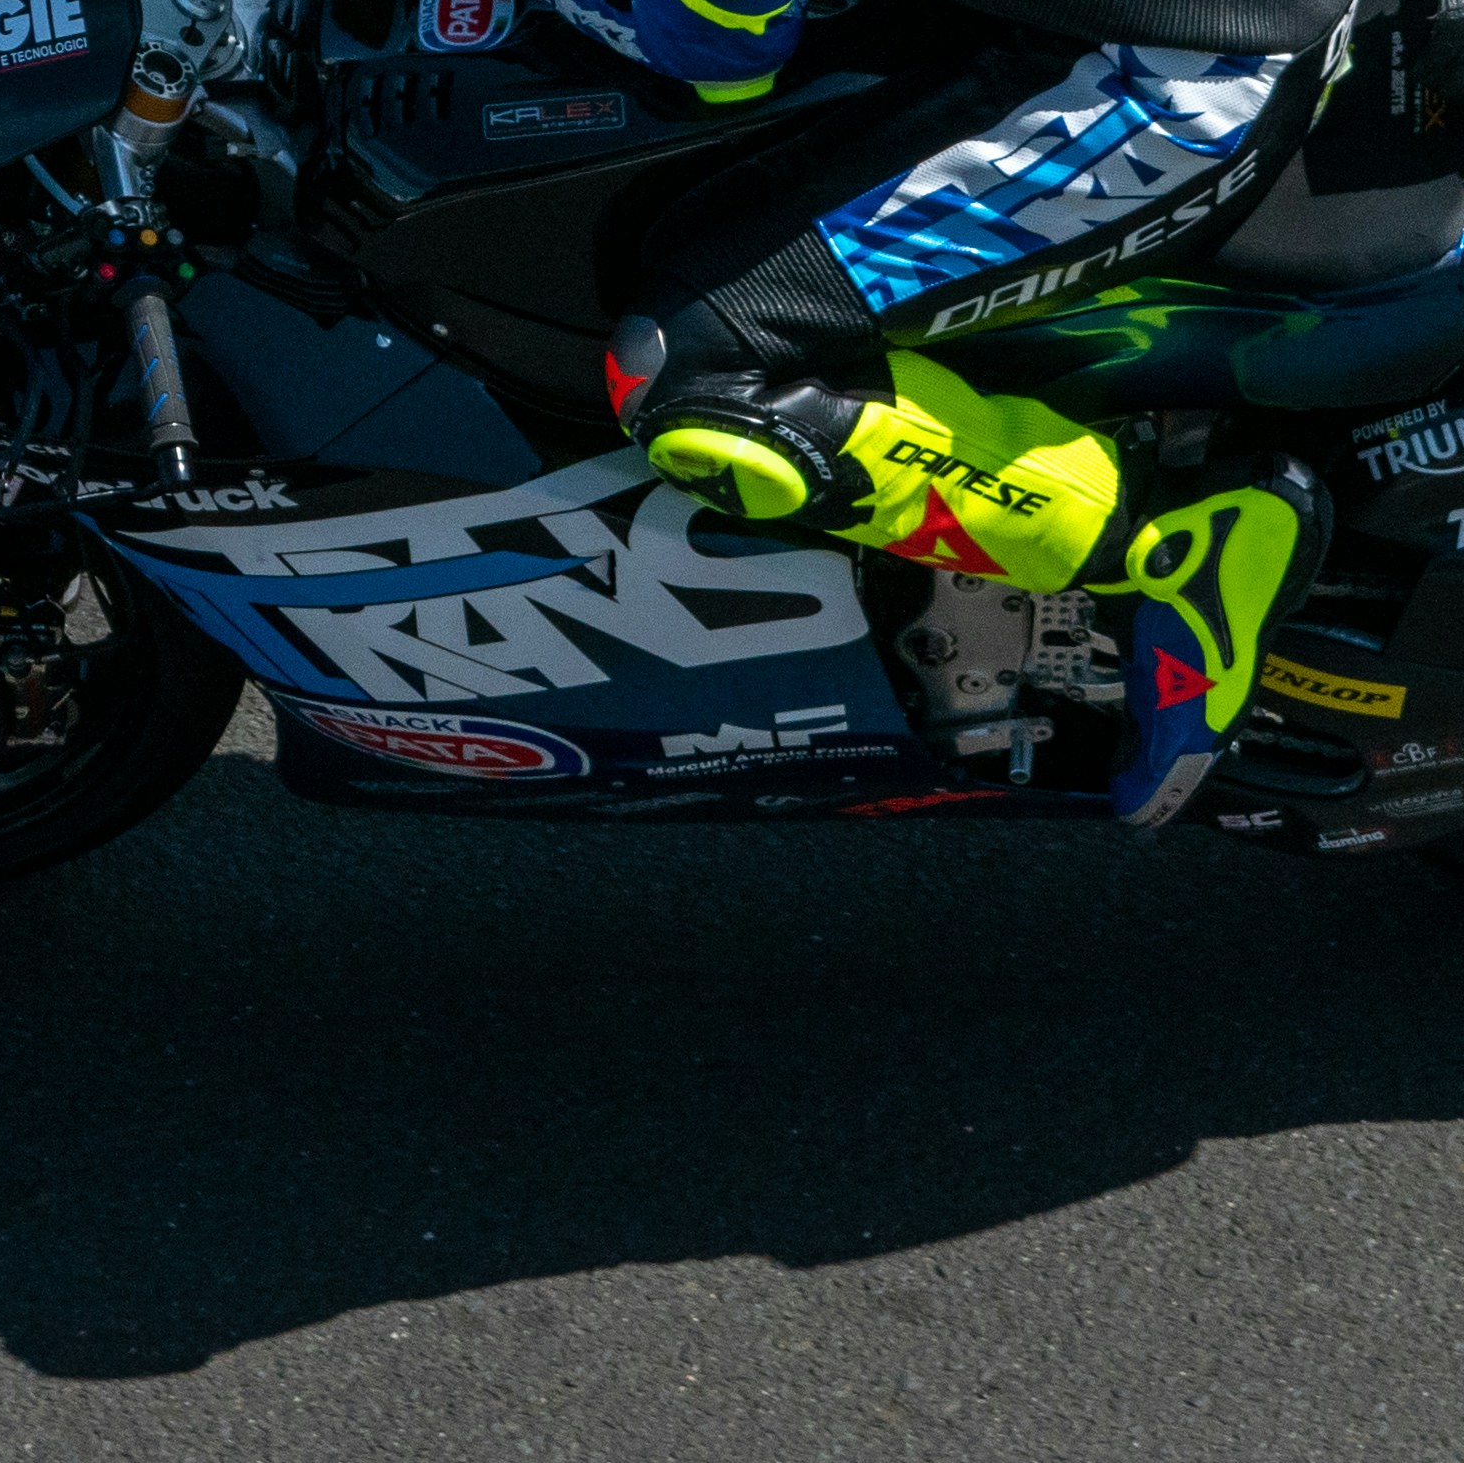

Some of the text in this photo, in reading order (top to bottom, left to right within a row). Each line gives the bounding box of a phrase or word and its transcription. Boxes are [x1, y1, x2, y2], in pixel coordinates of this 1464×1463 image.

[1, 53, 10, 68] E
[10, 37, 88, 65] TECNOLOGICI
[489, 98, 618, 126] KALEX
[1351, 398, 1448, 444] POWERED BY
[883, 439, 1052, 517] DAINESE
